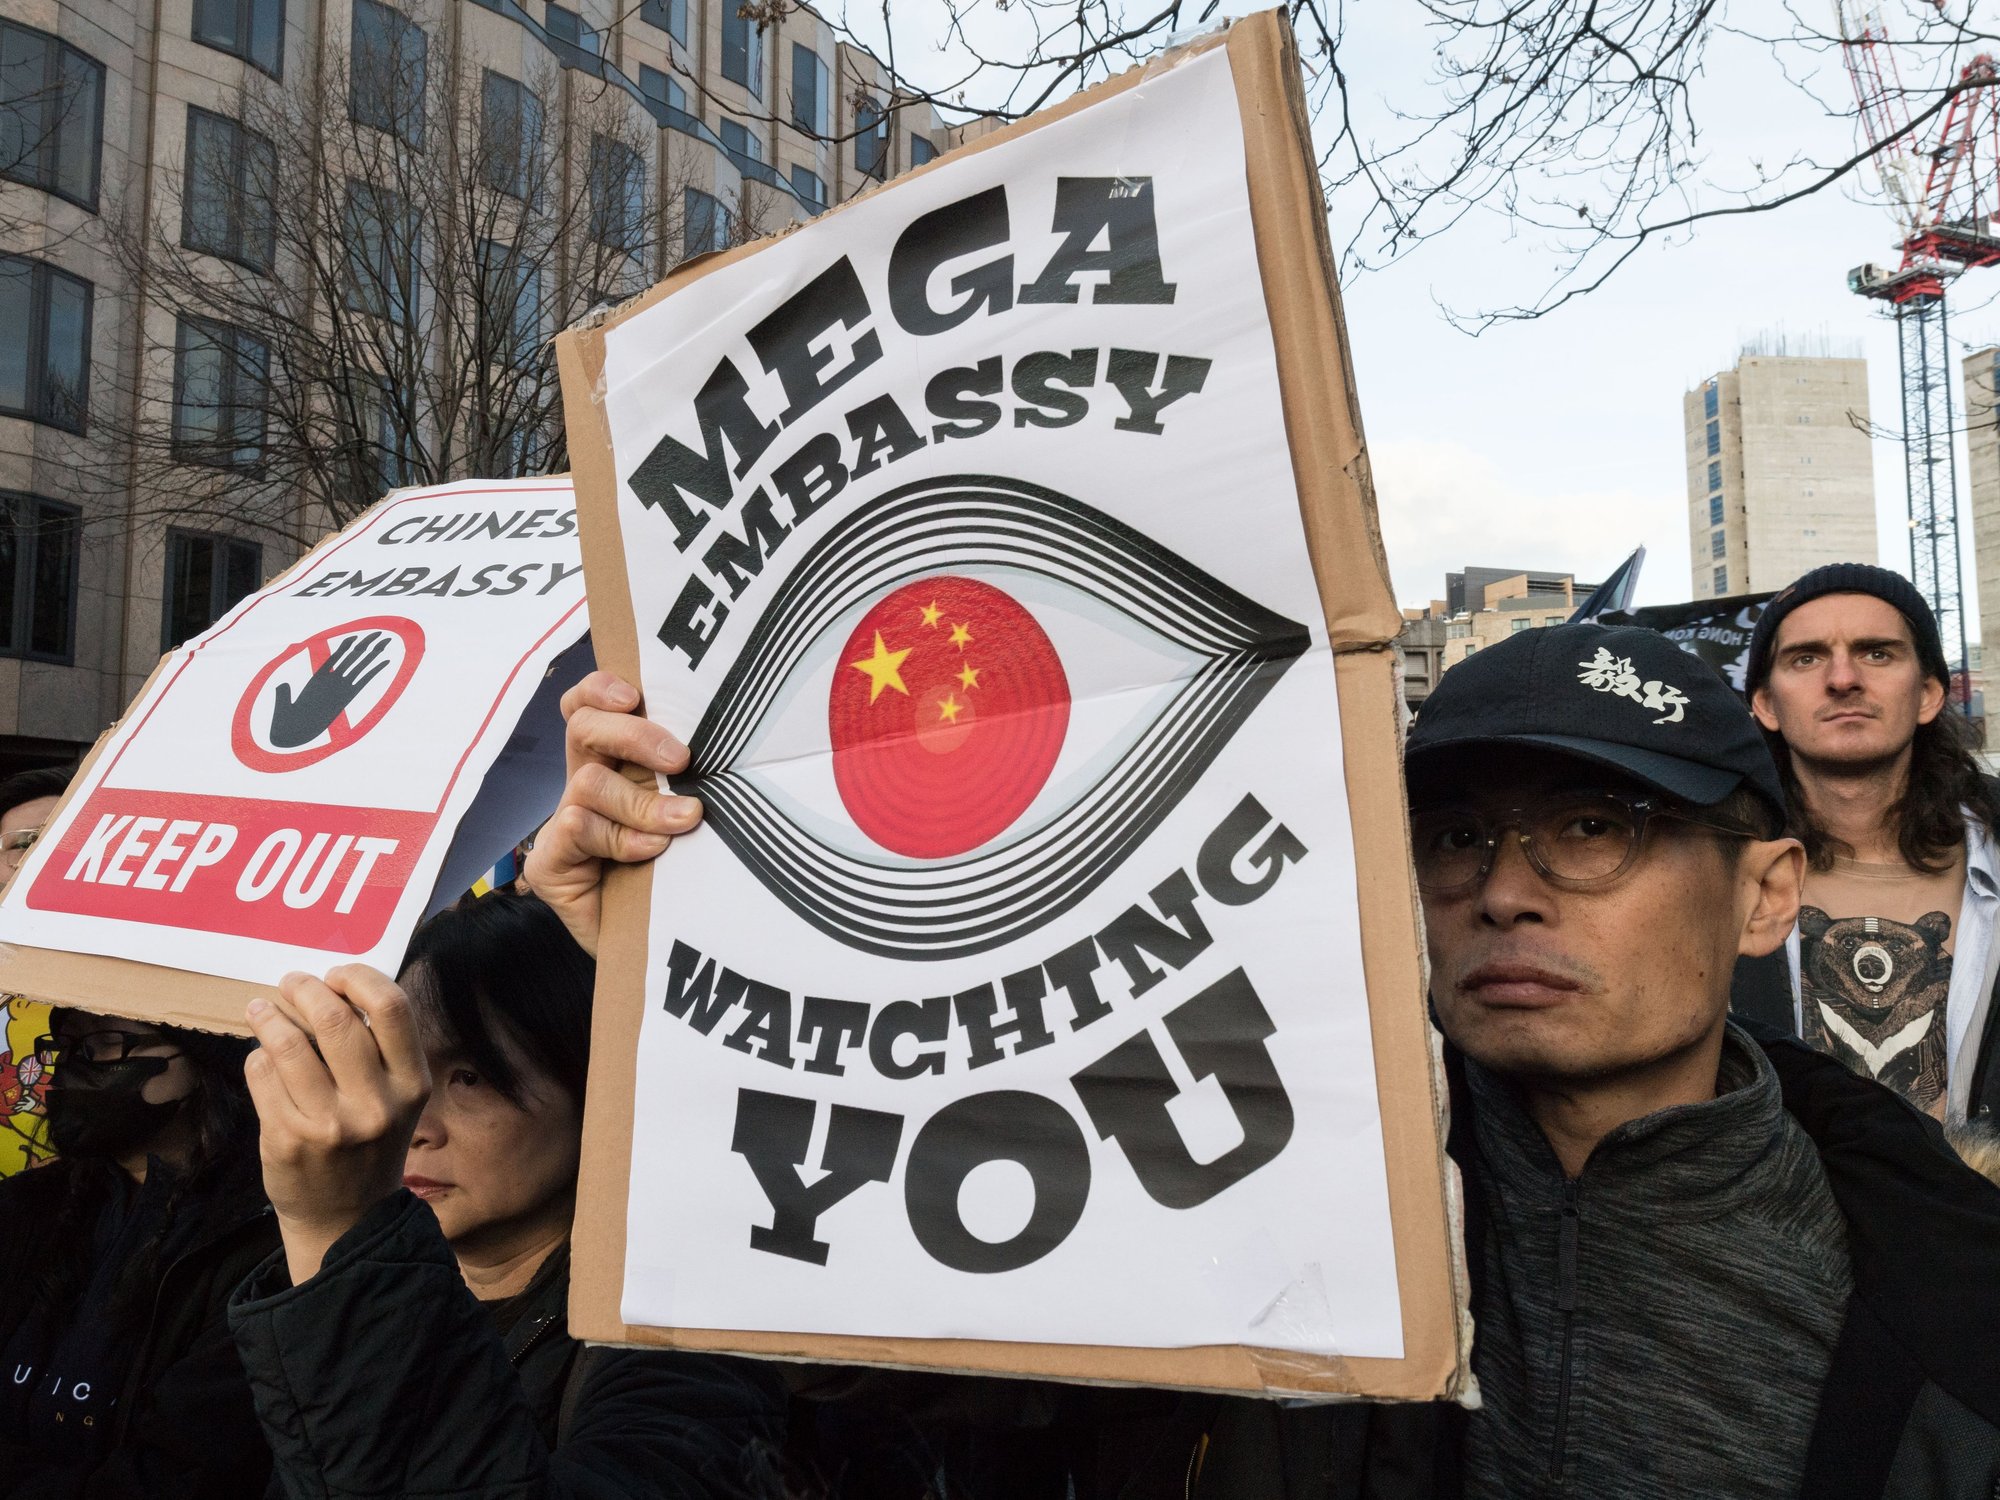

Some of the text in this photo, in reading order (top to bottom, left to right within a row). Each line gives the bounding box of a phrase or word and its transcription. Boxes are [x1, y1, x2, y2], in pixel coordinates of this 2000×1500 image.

[627, 176, 1178, 554] MEGA
[656, 347, 1213, 673] EMBASSY
[292, 563, 583, 597] EMBASSY
[377, 508, 582, 545] CHINES
[63, 813, 401, 915] KEEP OUT
[663, 791, 1309, 1081] WATCHING
[730, 965, 1295, 1274] YOU
